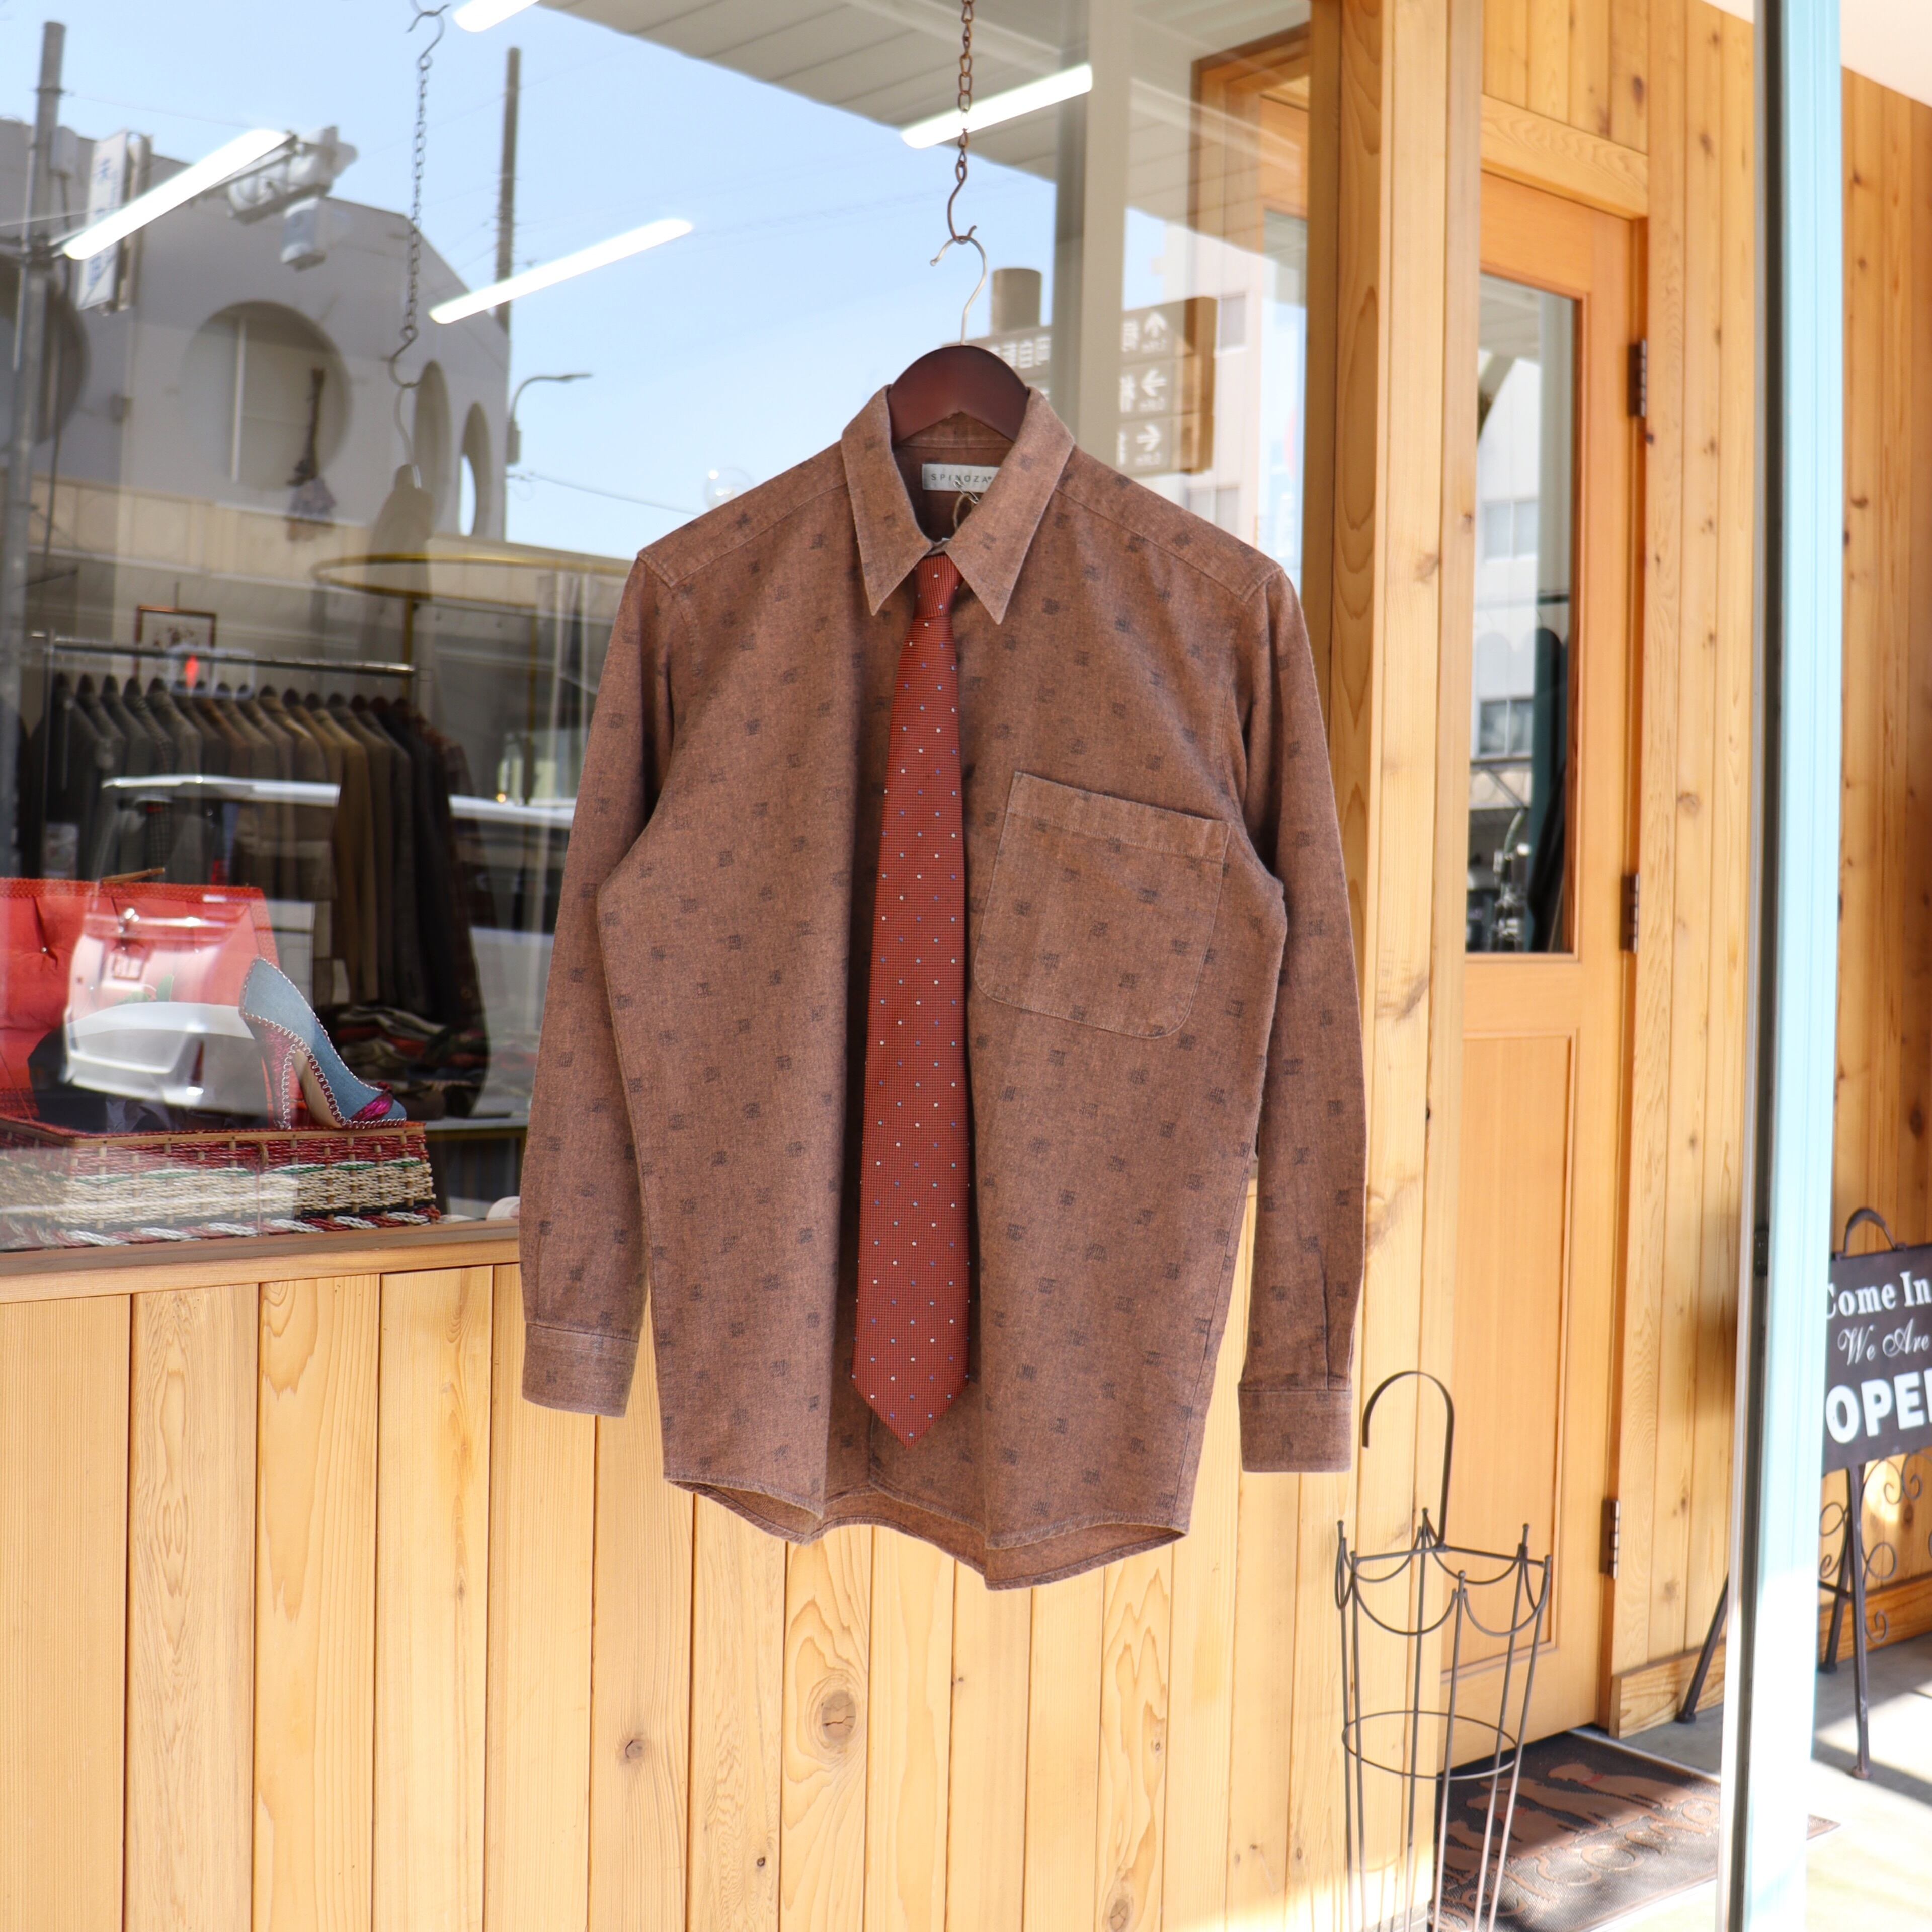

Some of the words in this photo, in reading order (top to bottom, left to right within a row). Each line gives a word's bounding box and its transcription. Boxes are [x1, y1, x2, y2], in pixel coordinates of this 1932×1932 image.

[931, 473, 988, 484] SPINOZA
[1900, 1271, 1932, 1307] In
[1837, 1324, 1876, 1366] We
[1882, 1318, 1930, 1358] Are
[1826, 1367, 1932, 1444] OPE
